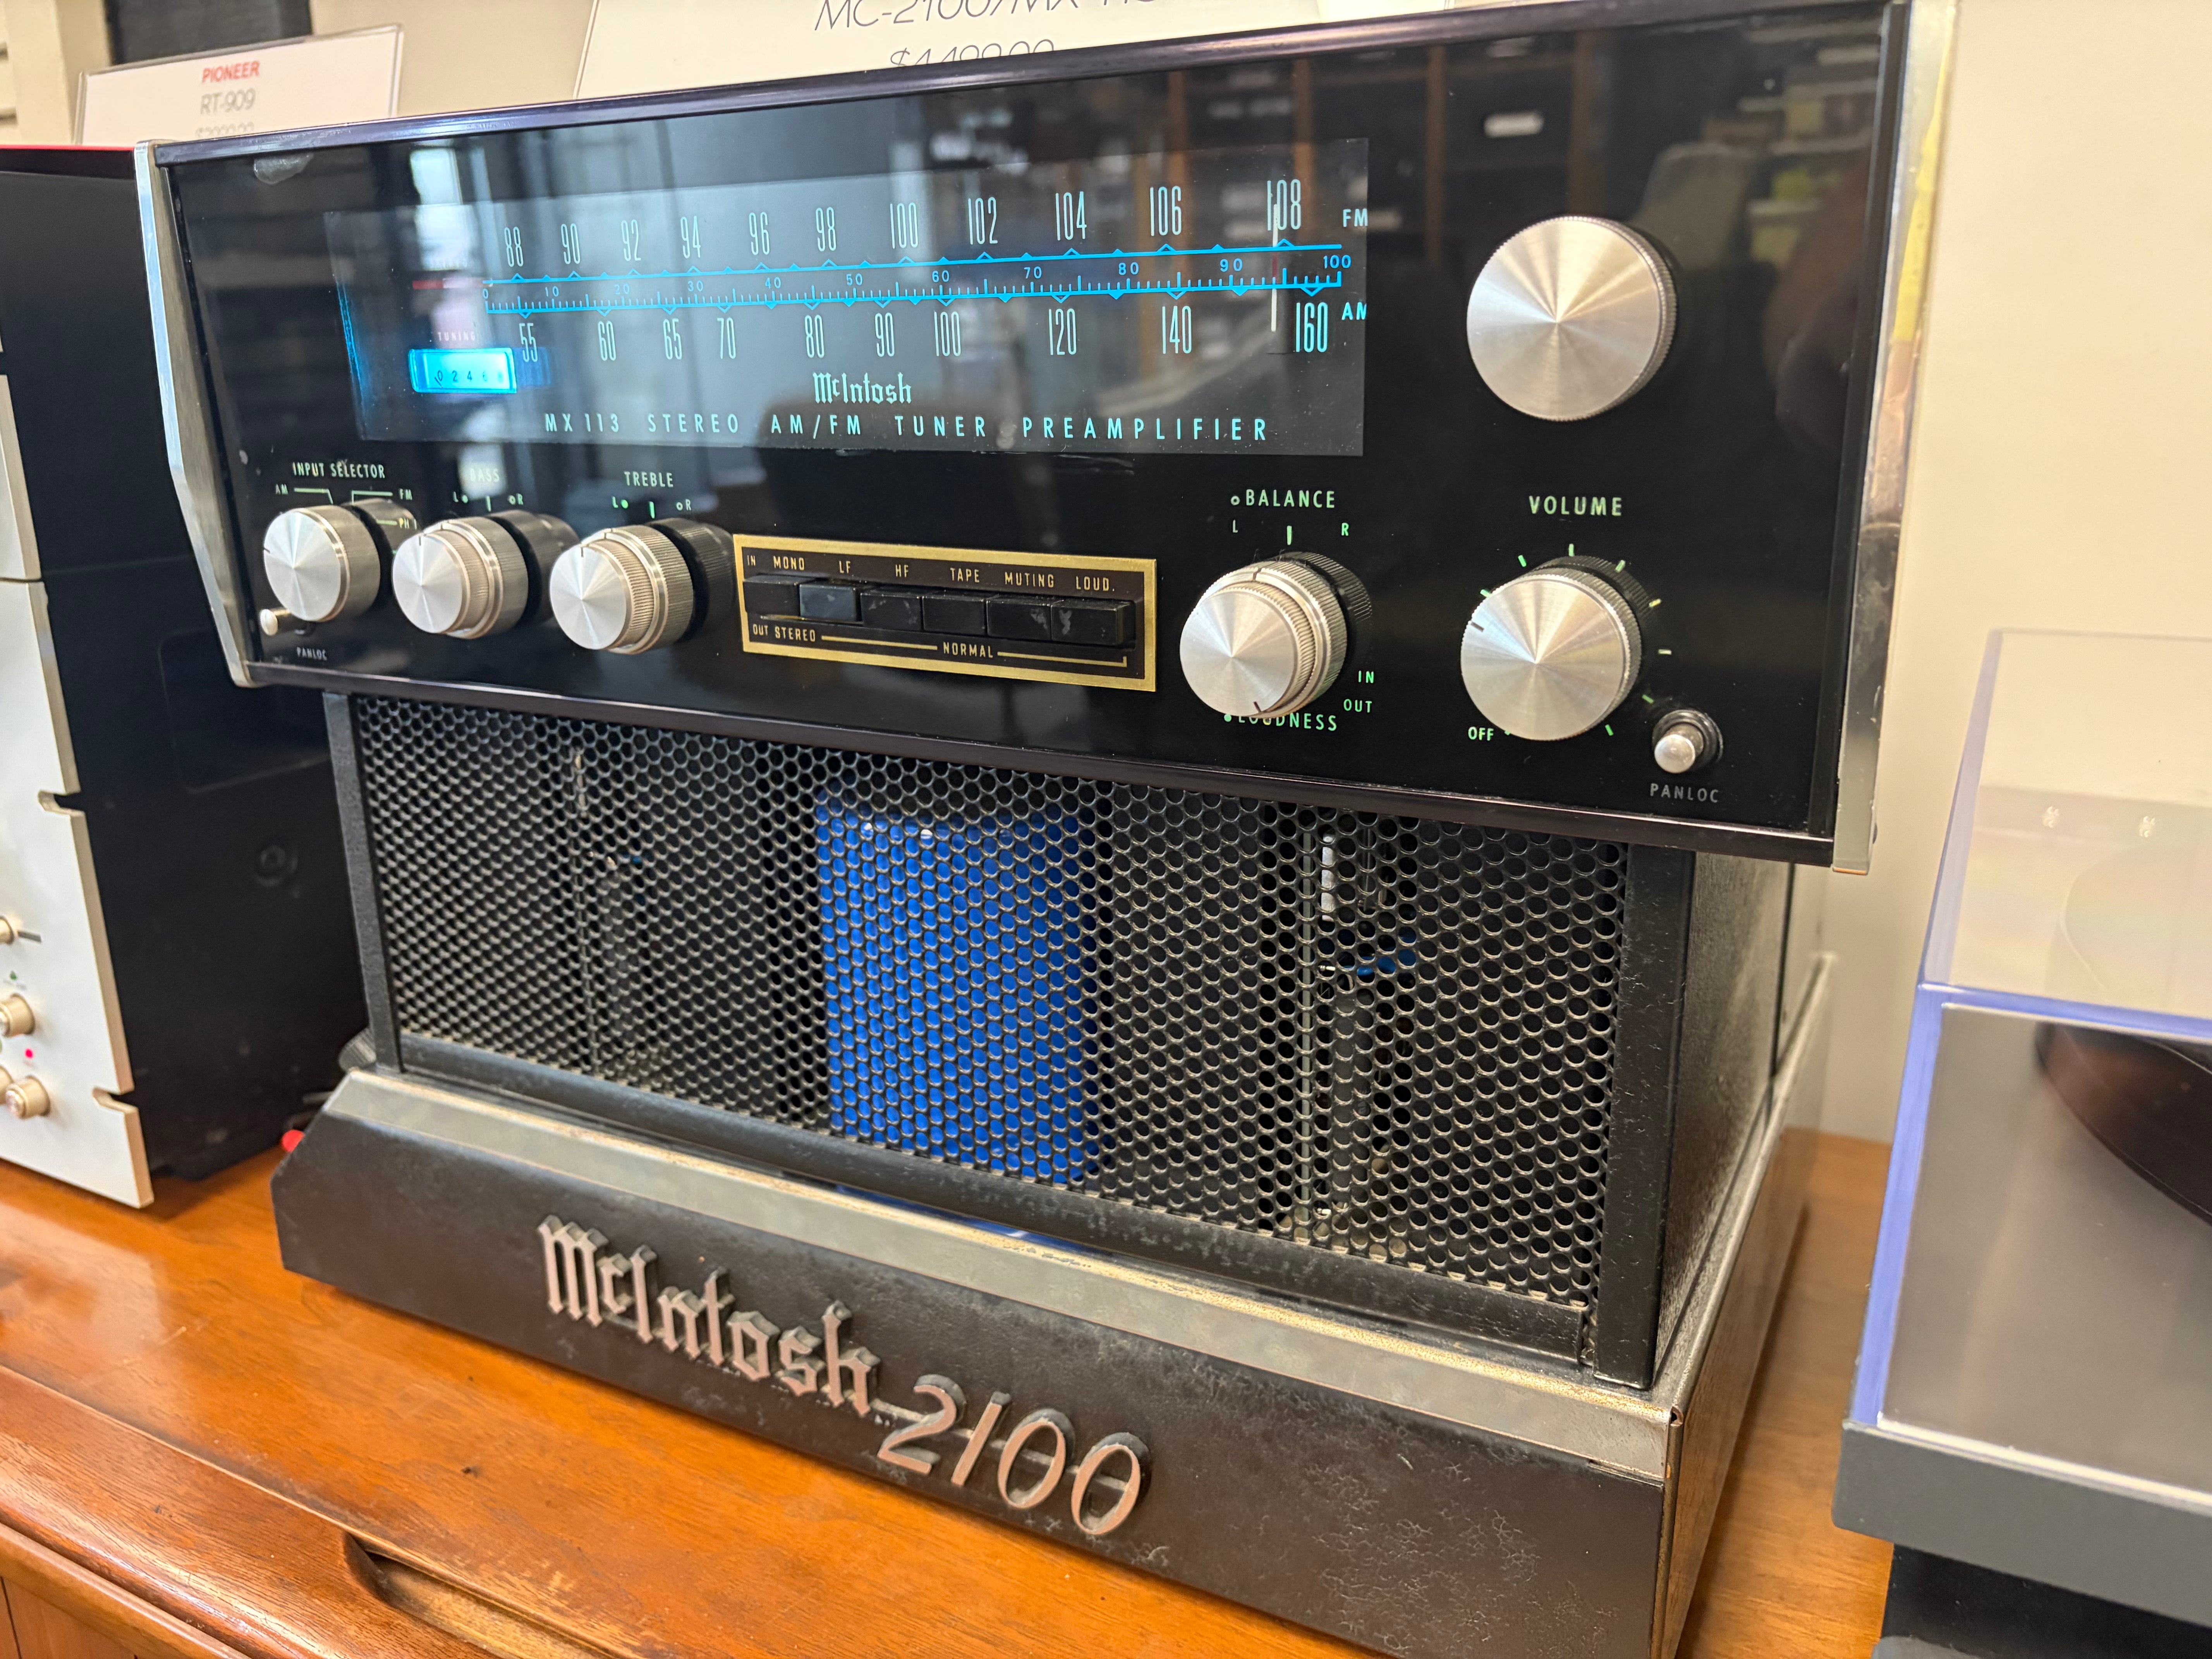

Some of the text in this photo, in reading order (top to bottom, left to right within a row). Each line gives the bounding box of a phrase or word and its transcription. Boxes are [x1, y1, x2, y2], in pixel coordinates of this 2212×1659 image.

[202, 60, 260, 83] PIONEER
[200, 87, 256, 115] RT-909
[505, 179, 1368, 267] 88 90 92 94 96 98 100 102 104 106 108 FM
[545, 286, 559, 297] 10
[615, 283, 629, 295] 20
[688, 280, 703, 292] 30
[765, 277, 781, 289] 40
[846, 273, 863, 286] 50
[932, 270, 949, 283] 60
[1024, 266, 1042, 279] 70
[1118, 262, 1139, 275] 80
[1220, 258, 1243, 272] 90
[1323, 255, 1352, 269] 100
[438, 332, 475, 341] TUNING
[519, 323, 538, 362] 55
[598, 321, 617, 361] 60
[663, 318, 682, 360] 65
[717, 317, 736, 359] 70
[805, 314, 824, 358] 80
[875, 313, 895, 357] 90
[934, 311, 961, 357] 100
[1048, 309, 1077, 355] 120
[1162, 306, 1192, 354] 140
[1296, 302, 1328, 352] 160
[452, 370, 457, 382] 2
[467, 371, 472, 381] 4
[813, 372, 912, 404] McIntosh
[545, 413, 1266, 441] MX 113 STEREO AM/FM TUNER PREAMPLIFIER
[292, 462, 386, 479] INPUT SELECTOR
[470, 468, 500, 482] BASS
[624, 471, 674, 488] TREBLE
[275, 484, 288, 495] AM
[399, 488, 412, 500] FM
[1246, 489, 1335, 508] BALANCE
[1529, 495, 1622, 516] VOLUME
[1233, 520, 1349, 536] L R
[747, 555, 1115, 592] IN MONO LF HF TAPE MUTING LOUD.
[753, 623, 993, 658] OUT STEREO NORMAL
[297, 647, 327, 661] PANLOC
[1358, 670, 1374, 684] IN
[1344, 699, 1372, 713] OUT
[1468, 726, 1494, 741] OFF
[1650, 783, 1719, 803] PANLOC
[538, 1214, 1153, 1536] McIntosh 2100
